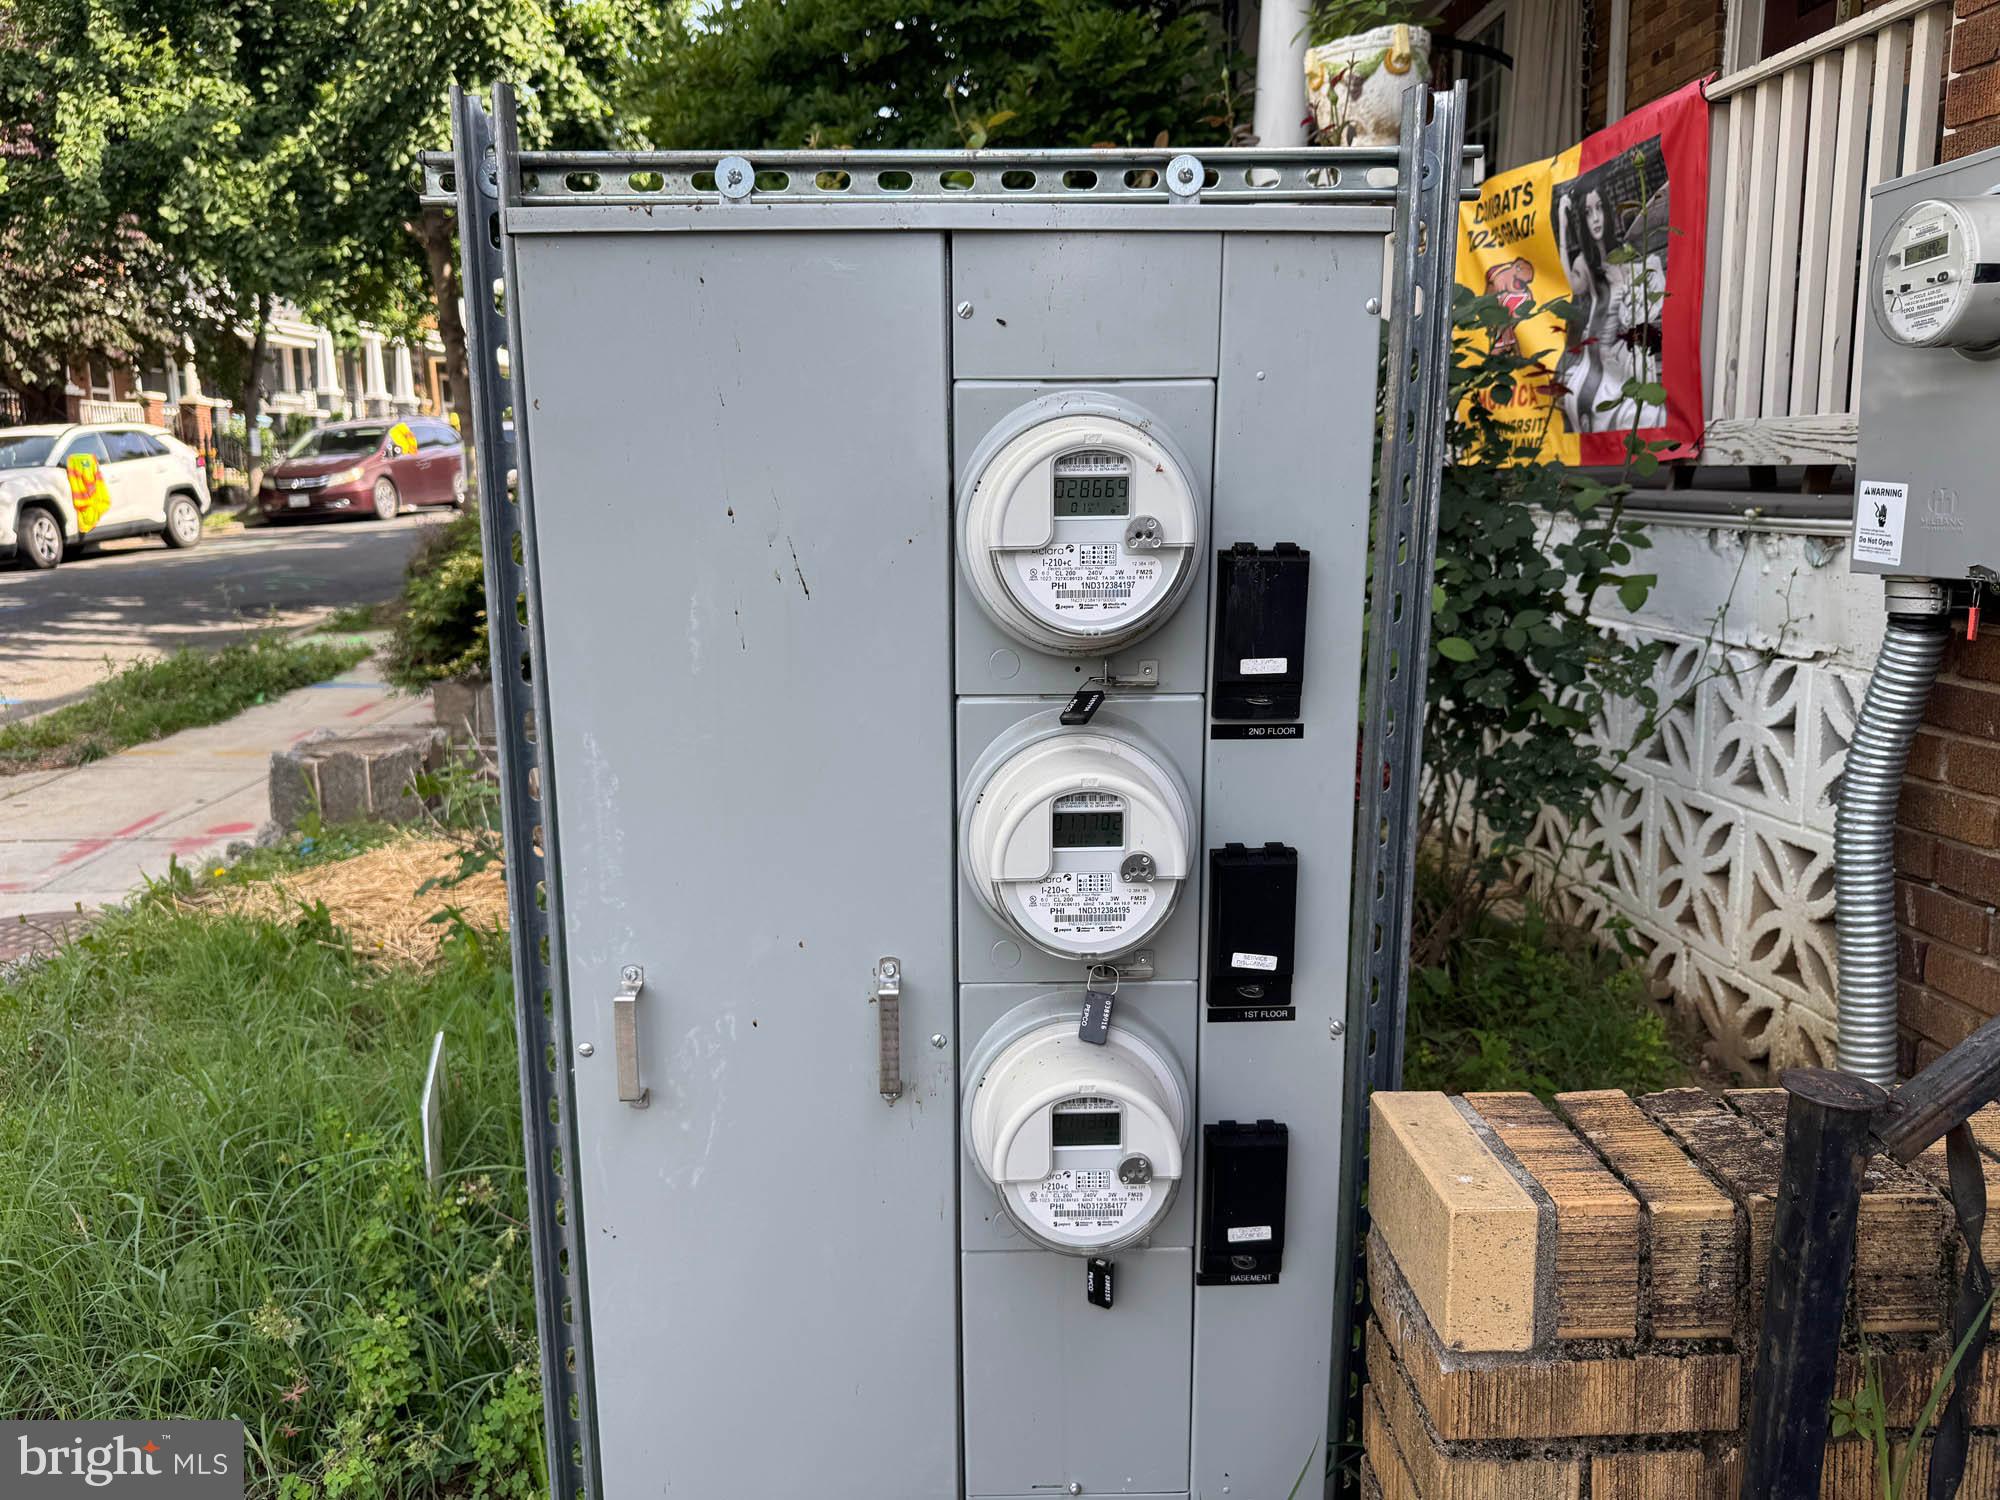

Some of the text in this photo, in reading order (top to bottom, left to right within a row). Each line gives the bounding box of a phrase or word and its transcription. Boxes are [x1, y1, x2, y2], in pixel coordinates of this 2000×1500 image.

[1056, 480, 1127, 498] 028669
[1870, 487, 1902, 498] WARNING
[1868, 536, 1878, 544] Not
[1878, 538, 1893, 547] Open
[1042, 559, 1072, 567] I-210+c
[1051, 581, 1135, 590] PHI 1ND312384197
[1267, 727, 1296, 735] FLOOR
[1082, 1004, 1091, 1026] PEPCO
[1230, 1274, 1271, 1282] BASEMENT
